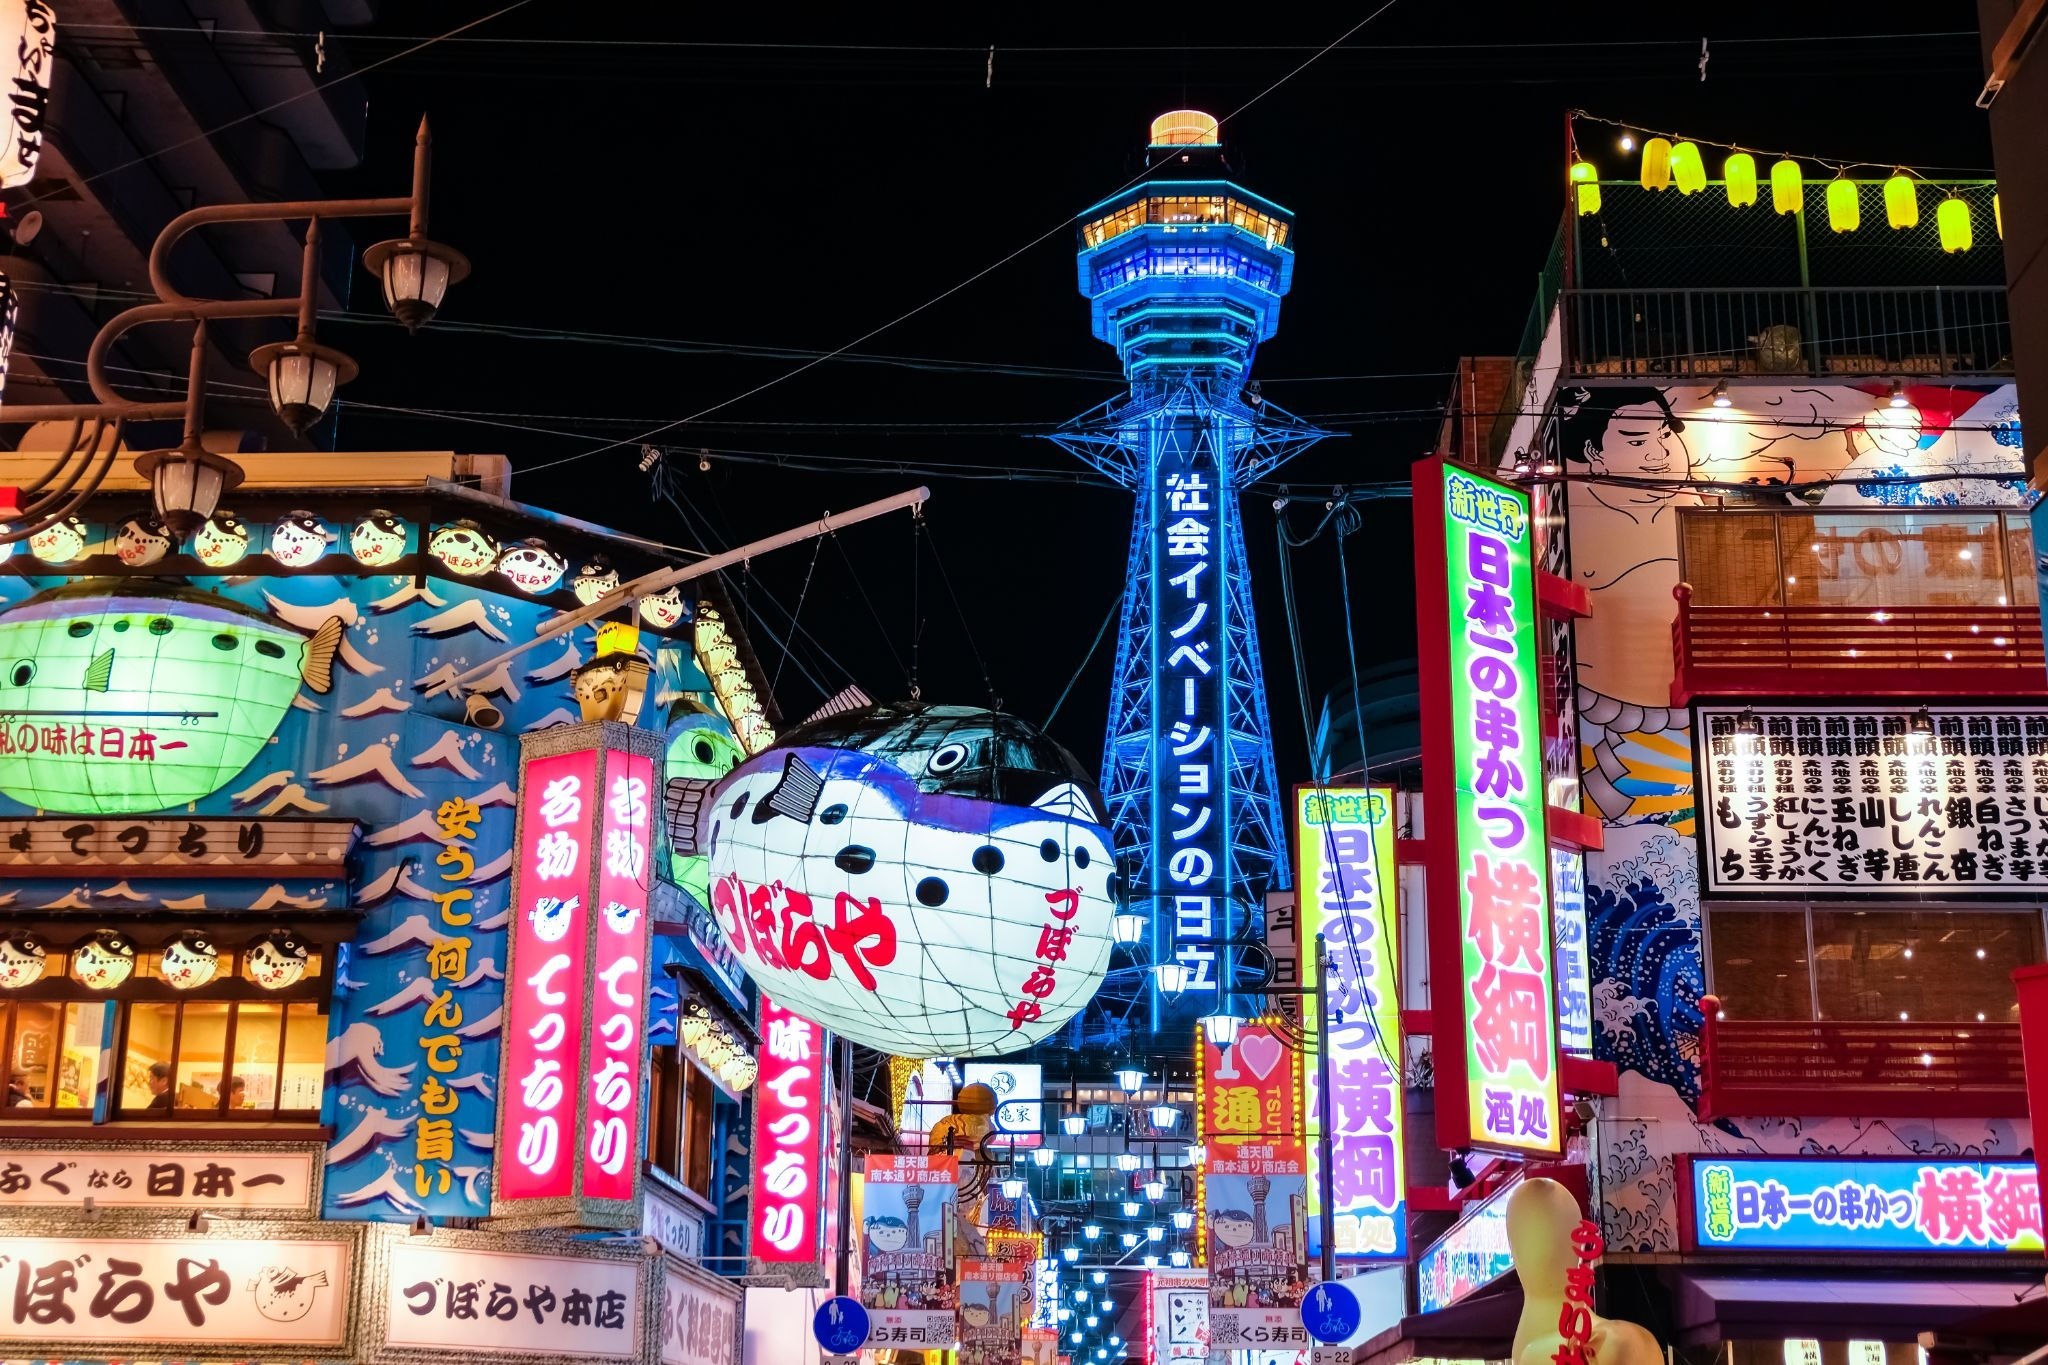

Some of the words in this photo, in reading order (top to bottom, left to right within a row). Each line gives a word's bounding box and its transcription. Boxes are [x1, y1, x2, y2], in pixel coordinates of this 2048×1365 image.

[1448, 476, 1524, 539] 新世界
[1466, 531, 1526, 849] 日本一の串かつ
[1165, 473, 1217, 990] 社会イノベーションの日立
[1711, 715, 1737, 757] 前頭
[1767, 715, 1796, 757] 前頭
[1796, 715, 1824, 757] 前頭
[1824, 715, 1853, 757] 前頭
[1853, 715, 1881, 757] 前頭
[1881, 715, 1909, 757] 前頭
[1938, 715, 1967, 757] 前頭
[1967, 715, 1996, 757] 前頭
[1996, 715, 2025, 757] 前頭
[536, 775, 582, 880] 名物
[606, 776, 647, 879] 名物
[1304, 794, 1387, 825] 新世界
[1716, 796, 1745, 881] もち
[1744, 796, 1777, 881] うずら玉子
[1772, 796, 1806, 881] 紅しょうが
[1801, 796, 1832, 881] にんにく
[1830, 796, 1863, 881] 玉ねぎ
[1859, 796, 1891, 881] 山芋
[1888, 796, 1921, 881] しし唐
[1916, 796, 1950, 881] れんこん
[1944, 796, 1979, 881] 銀杏
[1975, 796, 2008, 881] 白ねぎ
[2004, 796, 2037, 881] さつま芋
[714, 871, 897, 992] づぼらや
[1007, 884, 1084, 1030] づぼらや
[1321, 829, 1378, 1051] 日本一の串かつ
[1466, 853, 1550, 1082] 横綱
[412, 796, 482, 1197] 安うて何んでも旨い
[1236, 1145, 1274, 1159] 通天閣
[1311, 1056, 1396, 1209] 横綱
[1485, 1086, 1548, 1140] 酒処
[870, 1169, 952, 1183] 南本通り商店会
[893, 1156, 929, 1169] 通天閣
[1212, 1160, 1299, 1173] 南本通り商店会
[1707, 1169, 1733, 1237] 新世界
[1736, 1183, 1913, 1227] 日本一の串かつ
[1917, 1170, 2044, 1241] 横綱
[0, 1253, 232, 1327] ぼらや
[402, 1277, 627, 1330] づぼらや本店
[662, 1286, 733, 1365] ふぐ料理専門
[868, 1326, 927, 1343] ら寿司
[1239, 1326, 1308, 1343] くら寿司
